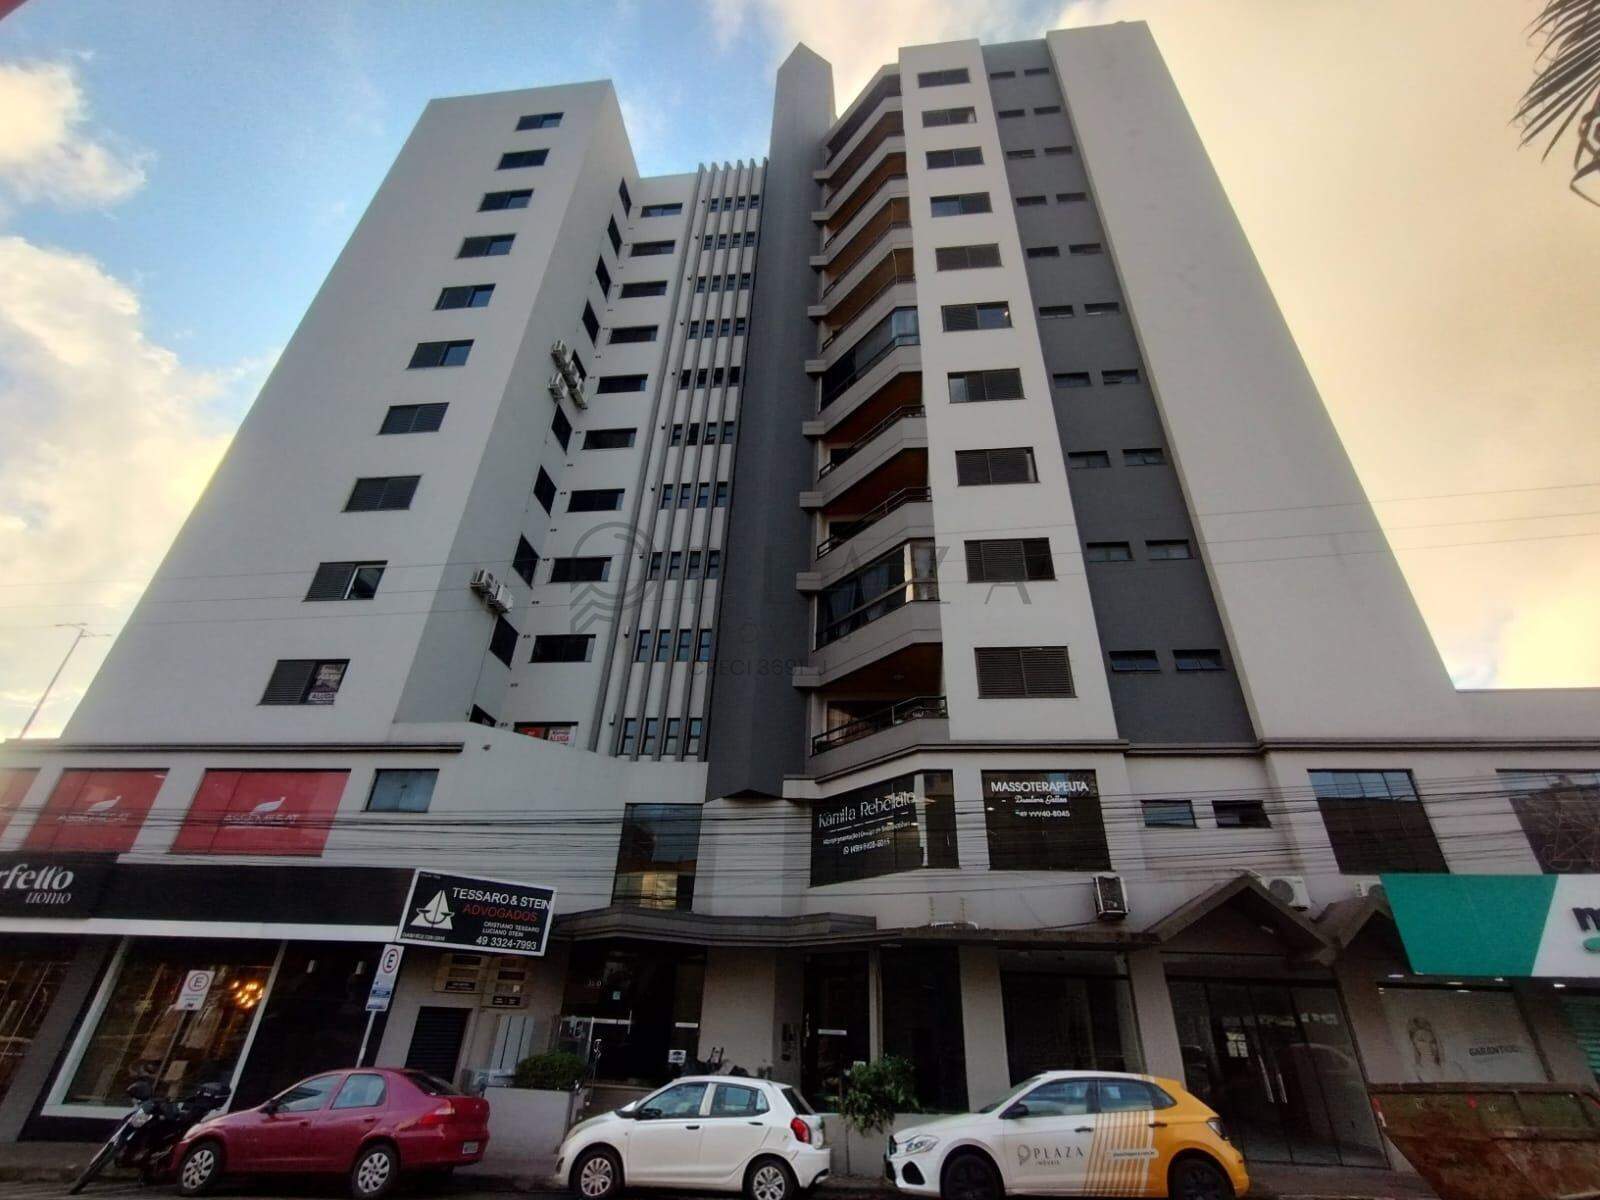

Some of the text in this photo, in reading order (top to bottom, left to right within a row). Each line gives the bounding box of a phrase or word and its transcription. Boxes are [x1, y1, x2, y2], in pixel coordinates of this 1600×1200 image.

[990, 781, 1089, 792] MASSOTERAPEUTA
[818, 806, 856, 828] Kamila
[26, 892, 72, 904] uomo
[453, 887, 551, 911] TESSARO & STEIN
[463, 903, 538, 922] ADVOGADOS
[482, 927, 507, 936] LUCIANO
[483, 921, 514, 930] CRISTIANO
[476, 935, 537, 950] 49 3324-7993
[1033, 1146, 1084, 1159] PLAZA
